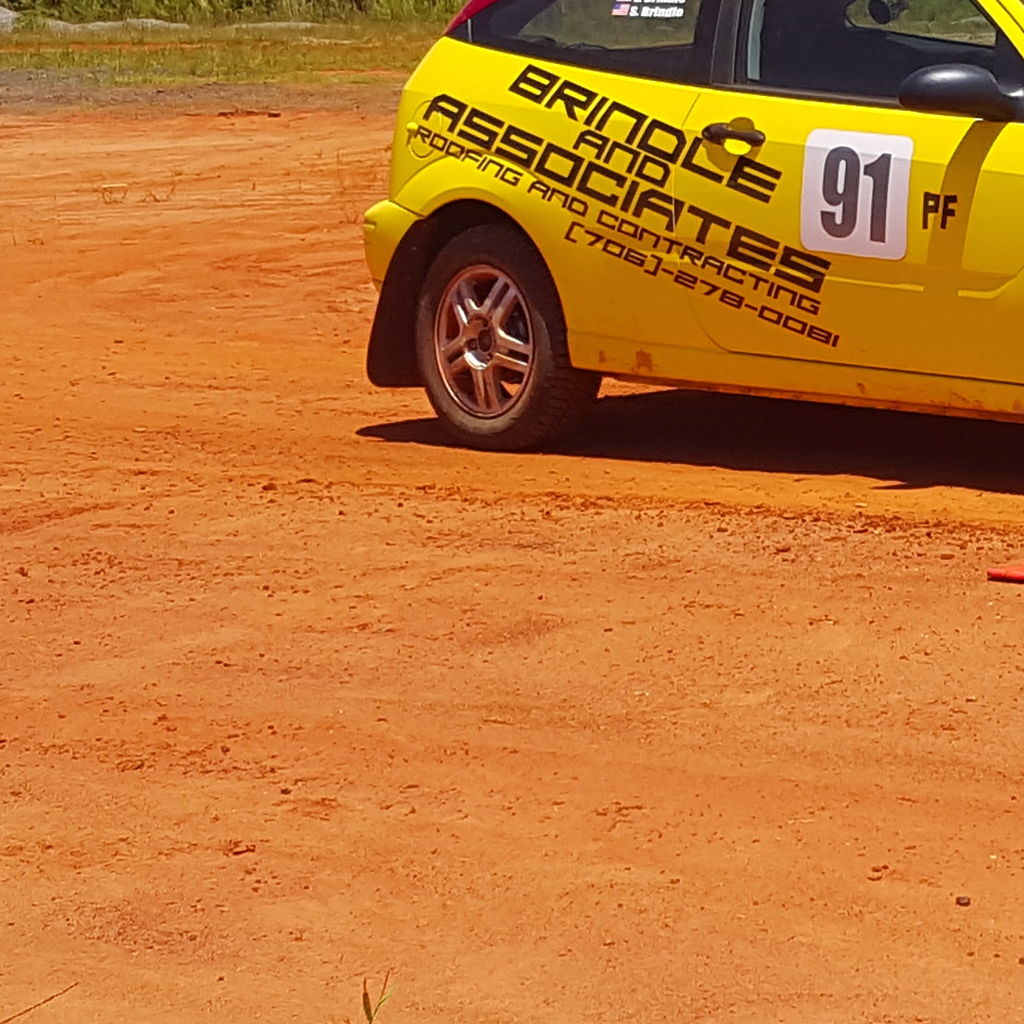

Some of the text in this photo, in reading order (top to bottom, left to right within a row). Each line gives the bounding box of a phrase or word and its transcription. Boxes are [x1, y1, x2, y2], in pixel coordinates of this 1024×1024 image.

[422, 93, 832, 294] ASSOCIATES
[508, 64, 783, 205] BRINDLE
[573, 129, 671, 189] AND
[414, 125, 822, 316] ROOFING AND CONTRACTING
[820, 146, 893, 244] 91
[922, 191, 958, 230] PF
